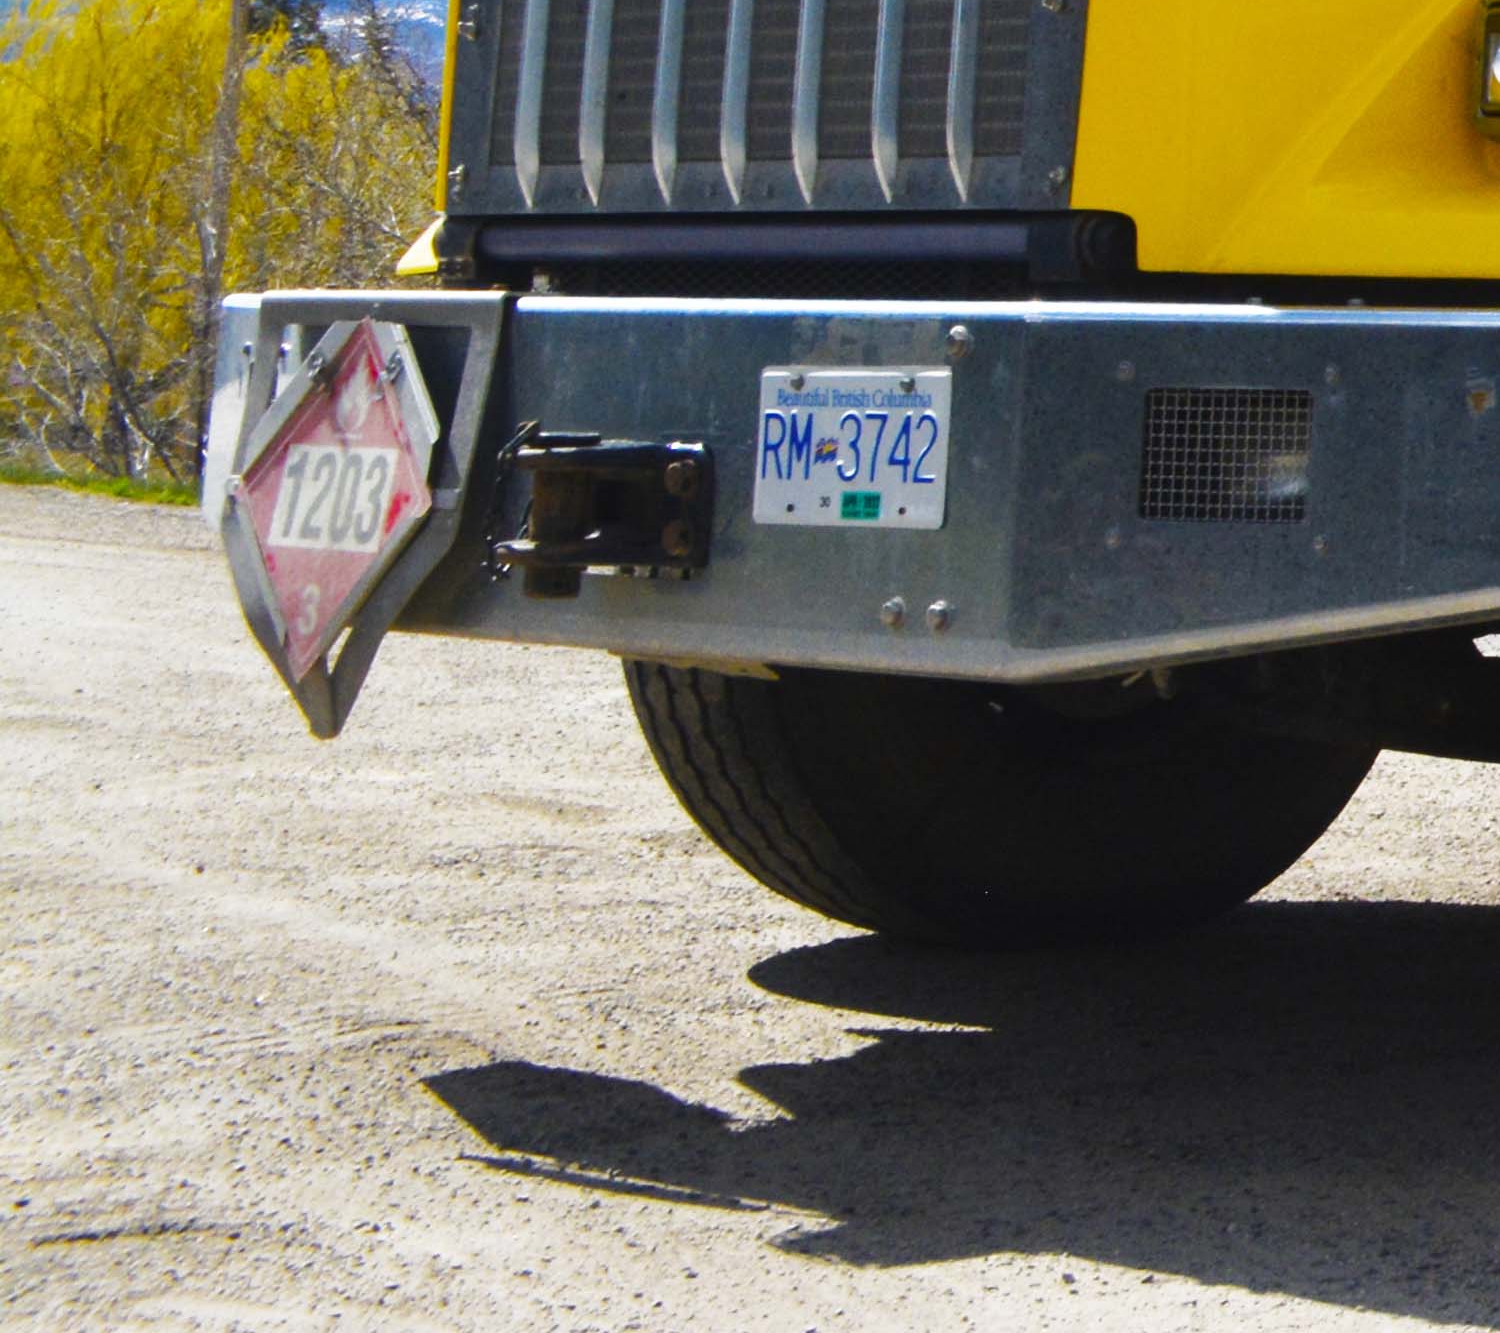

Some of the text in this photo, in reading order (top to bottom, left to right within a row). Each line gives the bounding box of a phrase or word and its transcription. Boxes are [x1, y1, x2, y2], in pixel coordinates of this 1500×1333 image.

[777, 387, 933, 408] Beautiful British Columbia
[761, 410, 939, 484] RM 3742
[280, 450, 391, 546] 1203
[297, 584, 321, 635] 3
